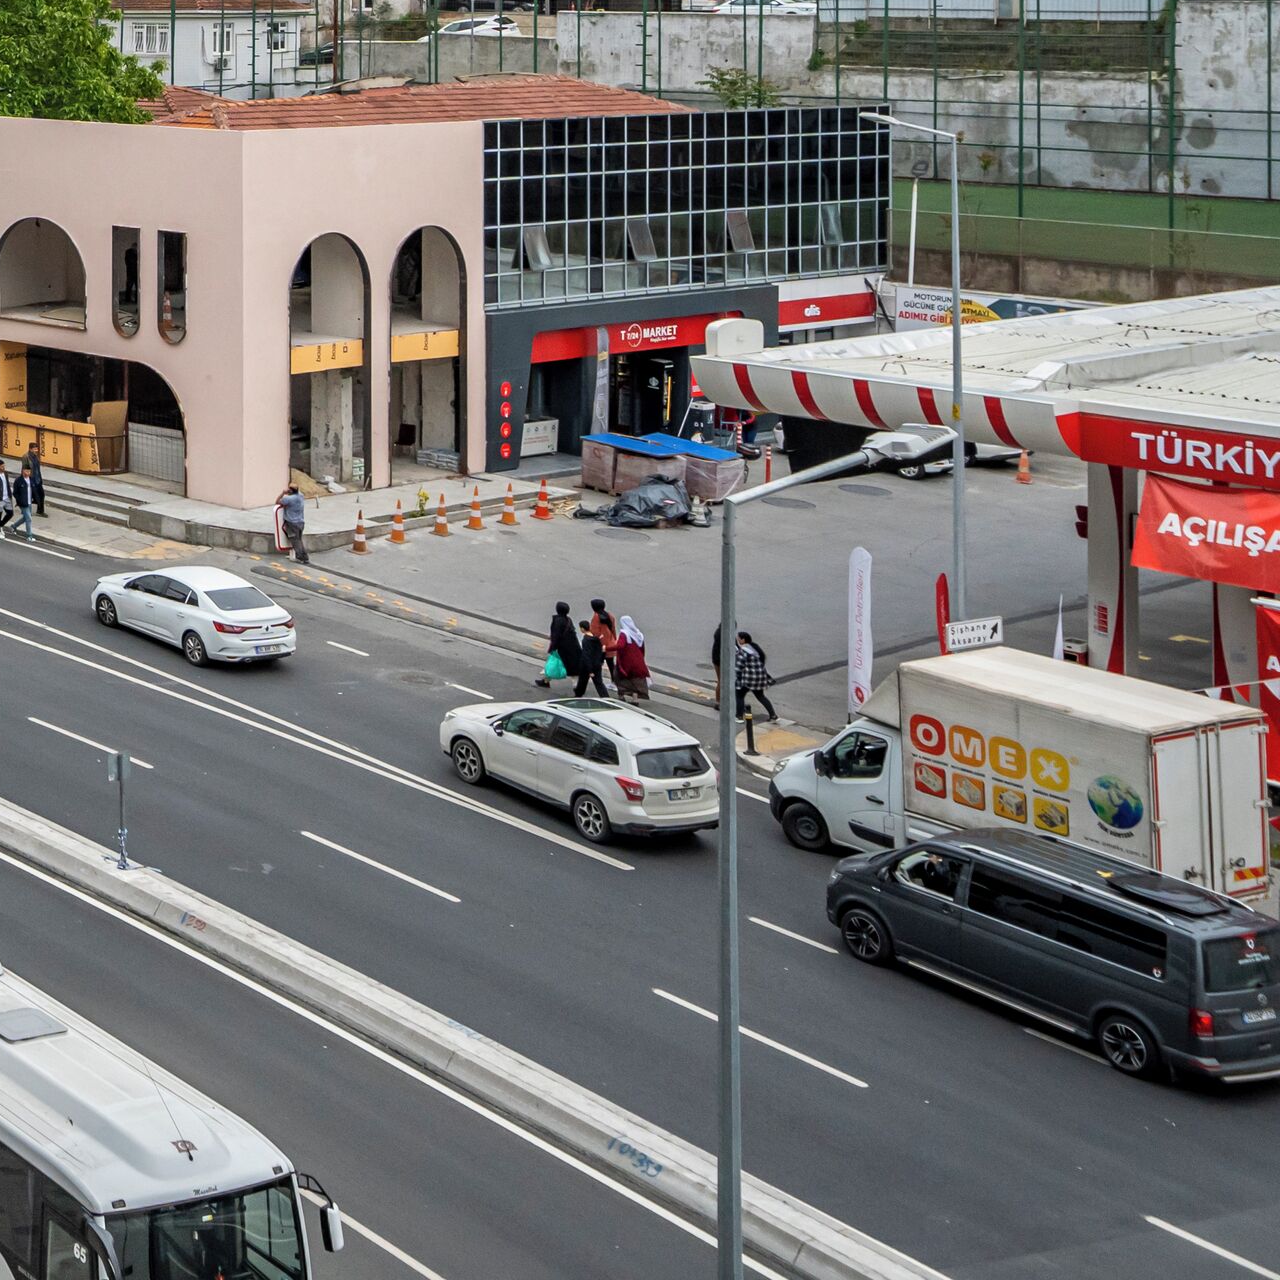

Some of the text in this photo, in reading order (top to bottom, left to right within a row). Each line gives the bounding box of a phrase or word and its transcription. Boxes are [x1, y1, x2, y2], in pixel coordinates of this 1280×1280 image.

[903, 300, 935, 311] GÜCÜNE
[961, 308, 990, 317] ATMAYI
[899, 311, 927, 321] ADIMIZ
[930, 312, 948, 324] GİBİ
[620, 330, 626, 341] T
[643, 325, 678, 338] MARKET
[1131, 430, 1280, 478] TÜRKİY
[951, 635, 987, 647] Aksaray
[73, 1242, 87, 1264] 65
